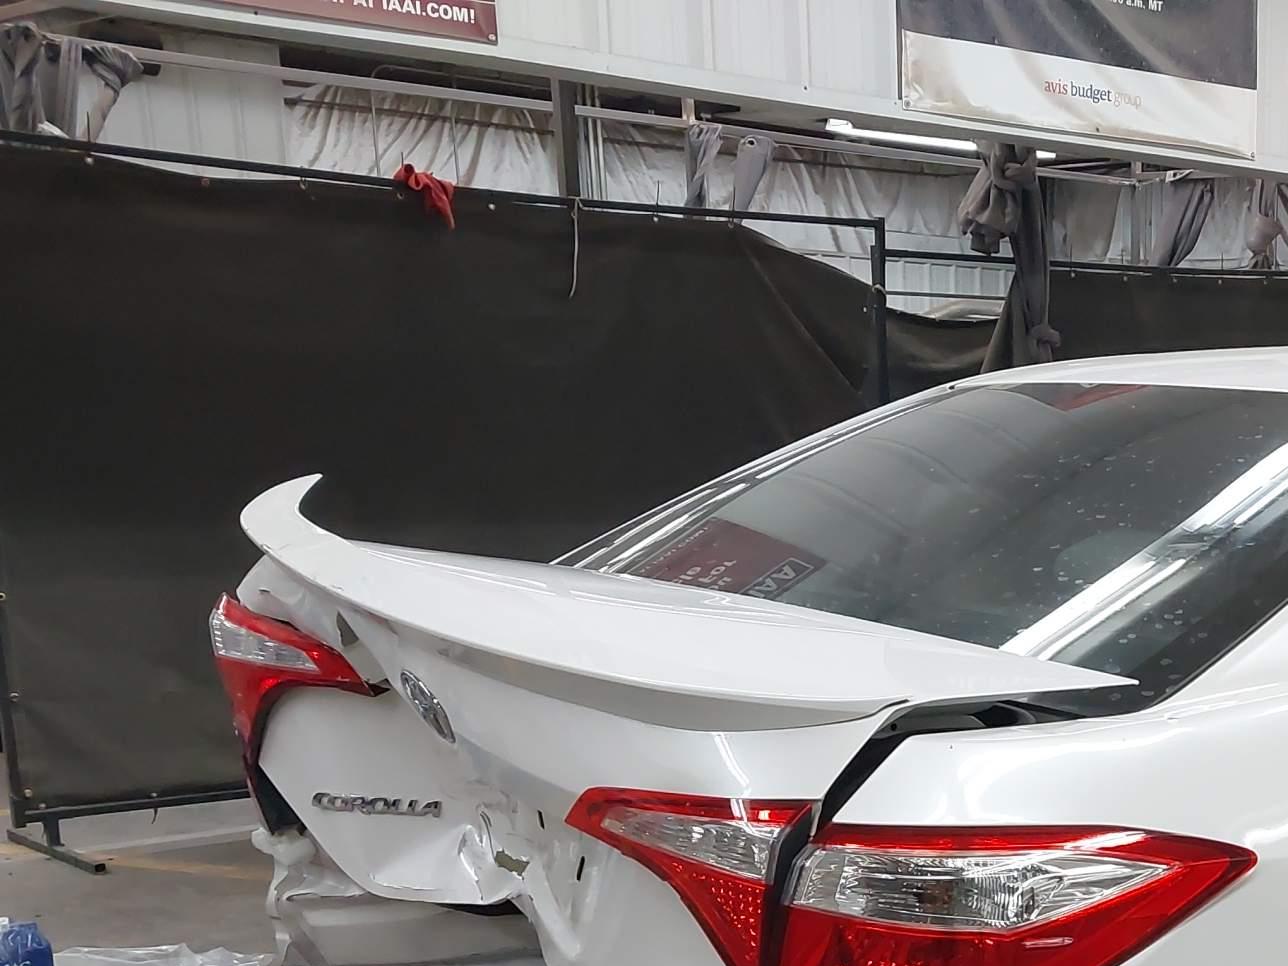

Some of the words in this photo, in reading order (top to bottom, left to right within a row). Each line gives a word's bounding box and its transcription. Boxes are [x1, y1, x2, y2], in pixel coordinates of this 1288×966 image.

[1148, 0, 1164, 12] MT
[1044, 79, 1068, 95] avis
[1070, 81, 1113, 103] budget
[1113, 91, 1142, 110] group
[311, 792, 443, 818] COROLLA
